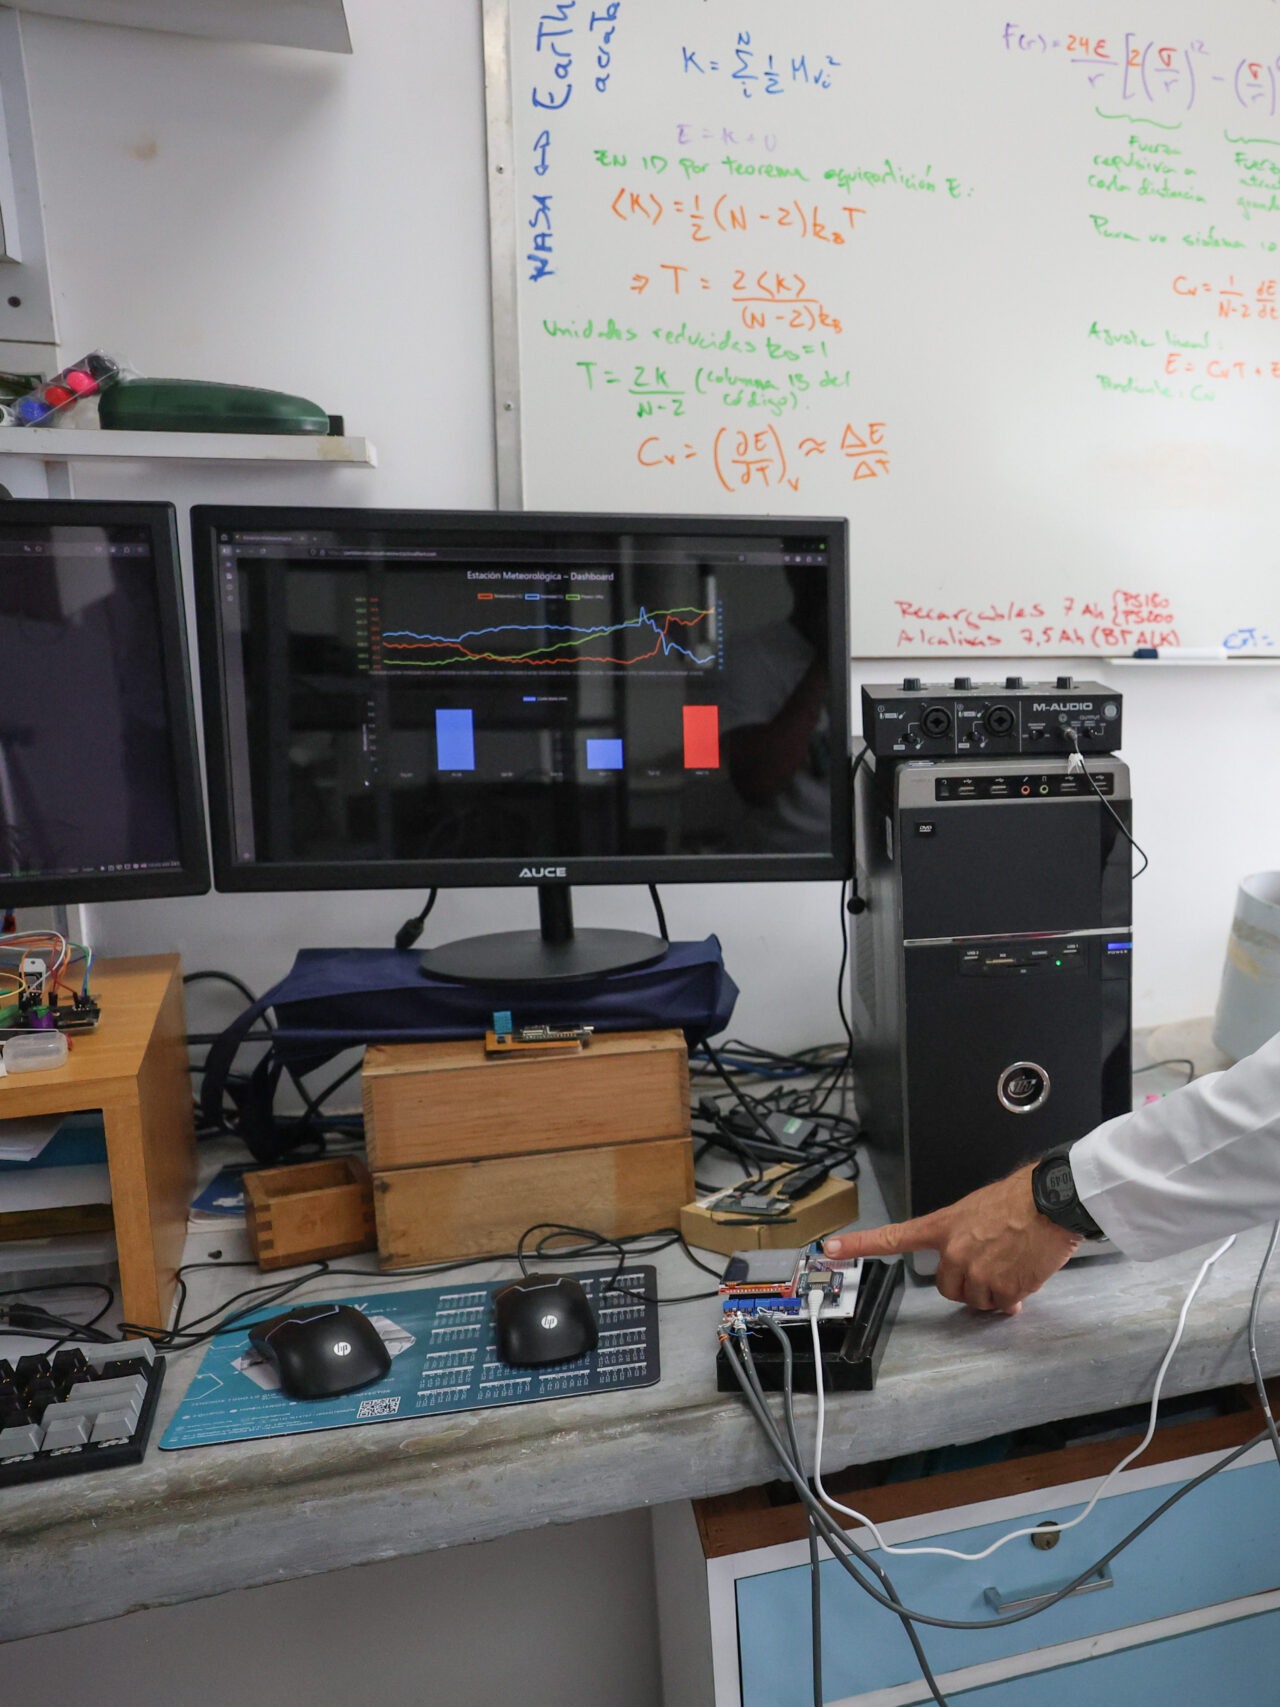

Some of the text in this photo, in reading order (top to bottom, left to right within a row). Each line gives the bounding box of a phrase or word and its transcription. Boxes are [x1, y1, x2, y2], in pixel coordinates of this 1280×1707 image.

[526, 194, 555, 282] NASA
[467, 570, 500, 580] Estación
[502, 570, 562, 582] Meteorológica
[570, 571, 615, 581] Dashboard
[1033, 702, 1094, 712] M-AUDIO
[518, 867, 567, 878] AUCE
[333, 1341, 352, 1356] hp
